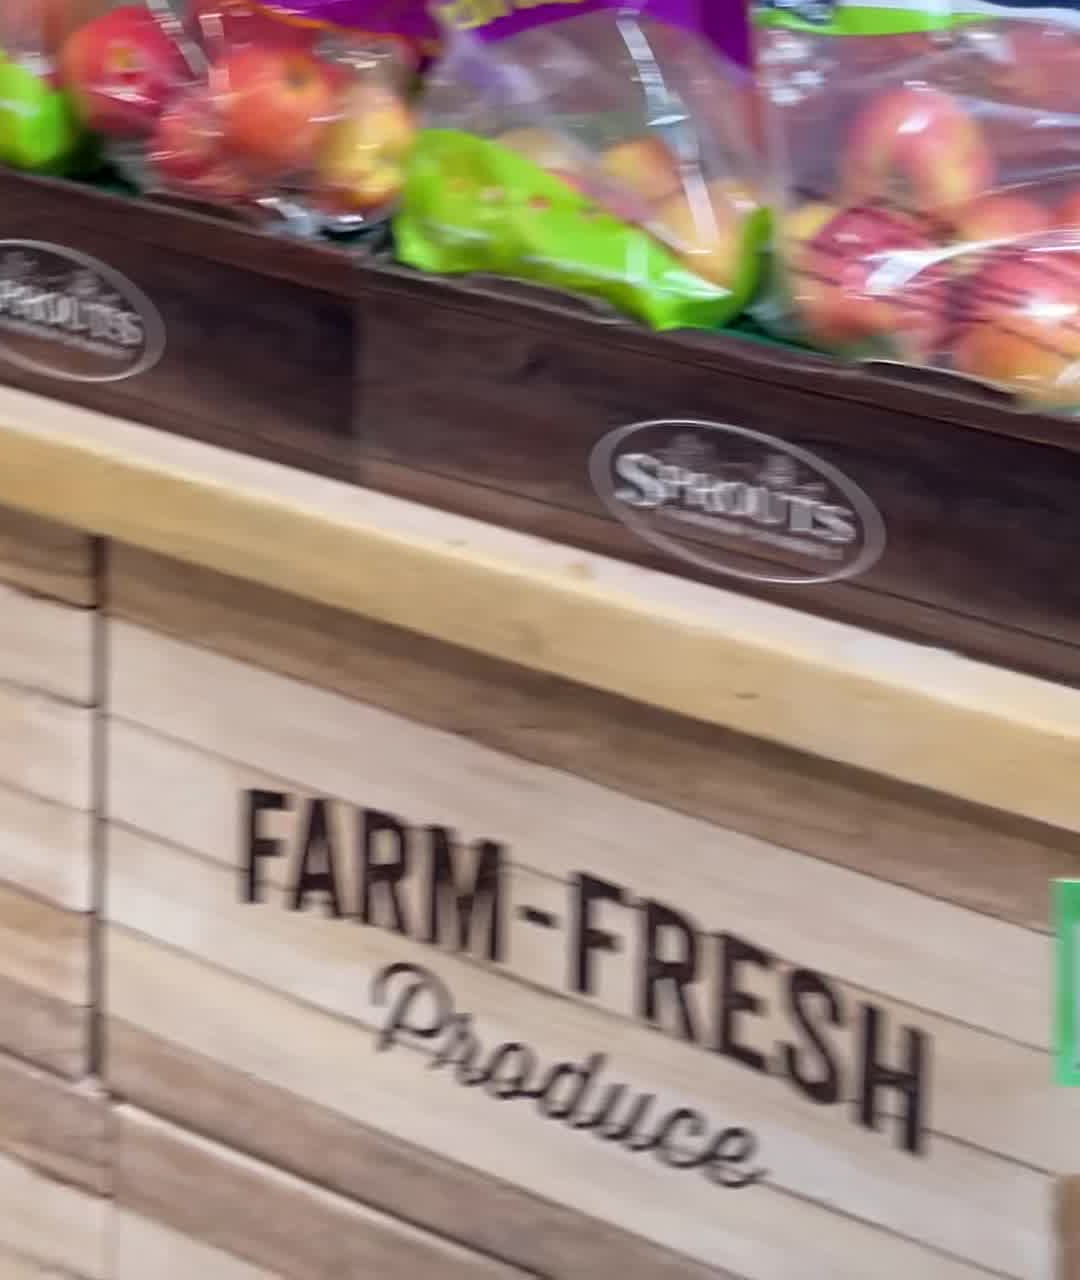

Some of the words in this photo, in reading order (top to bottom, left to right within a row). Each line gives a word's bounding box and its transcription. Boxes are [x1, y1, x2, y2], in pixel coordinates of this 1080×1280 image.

[613, 450, 858, 544] SPROUTS
[237, 786, 935, 1159] FARM-FRESH
[370, 961, 771, 1189] Produce
